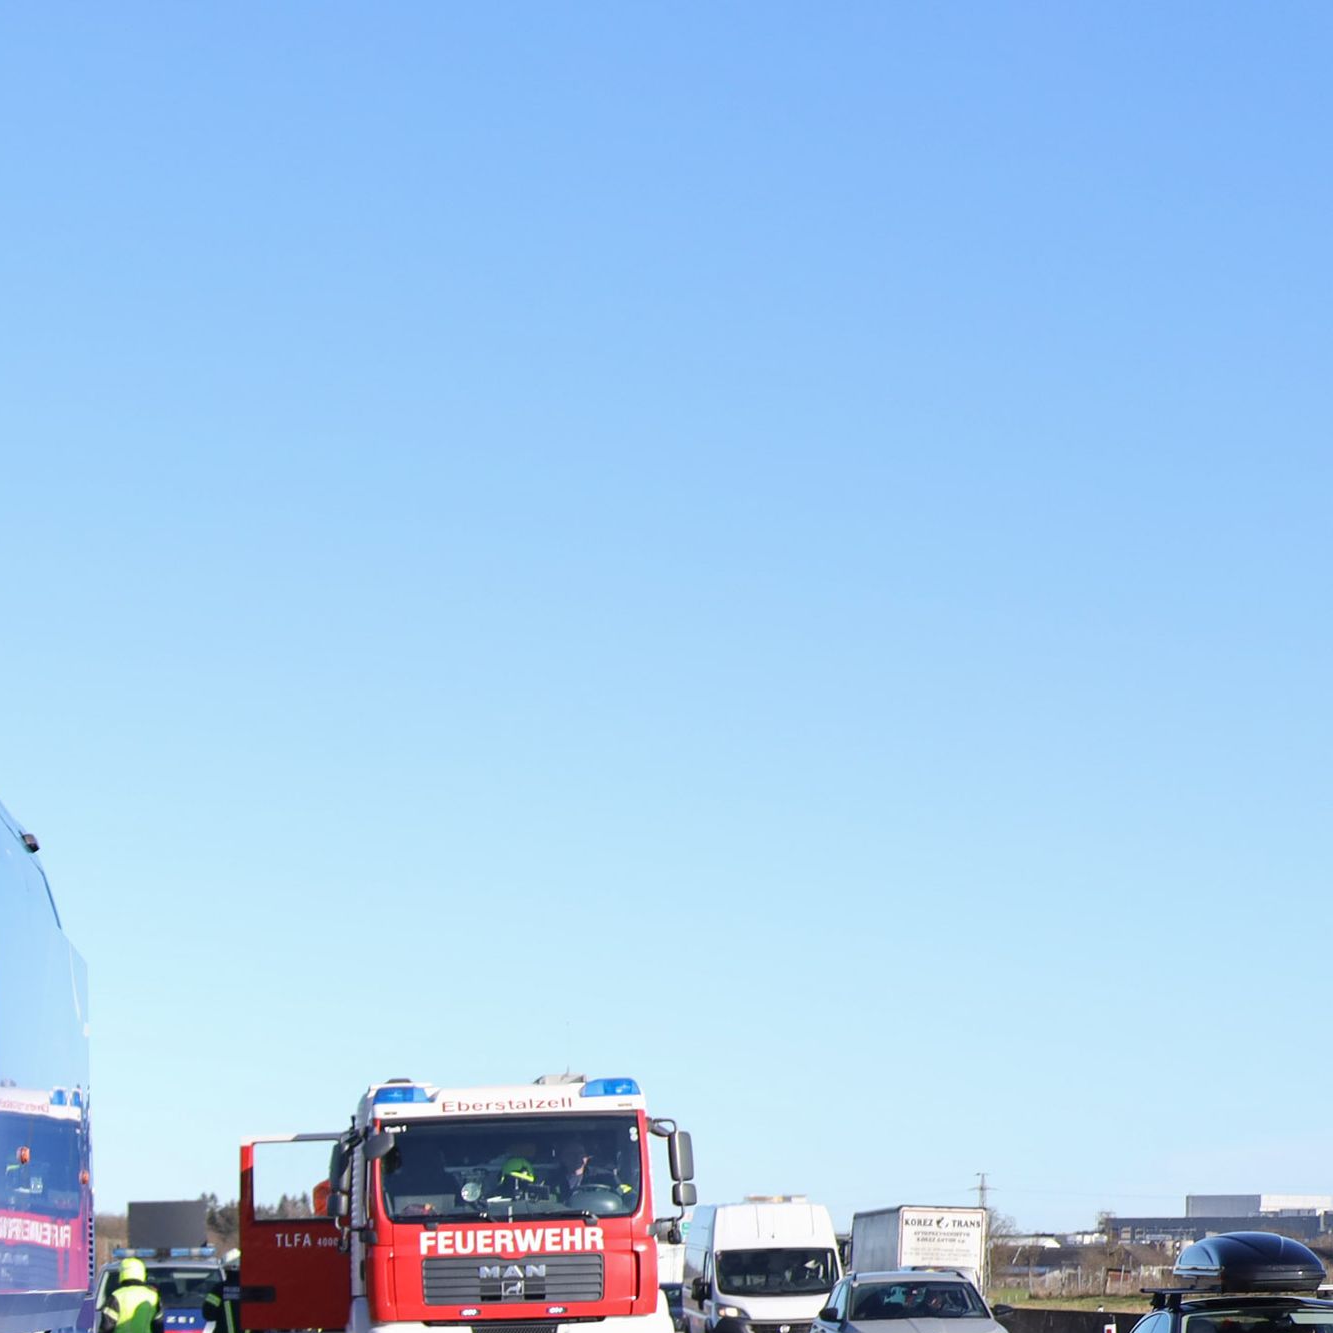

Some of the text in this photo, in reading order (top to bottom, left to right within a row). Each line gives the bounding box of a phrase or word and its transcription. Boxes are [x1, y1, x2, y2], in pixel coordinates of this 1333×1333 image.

[441, 1097, 573, 1114] Eberstalzell
[904, 1218, 981, 1229] KOREZ TRANS
[275, 1232, 311, 1248] TLFA
[419, 1226, 605, 1255] FEUERWEHR
[478, 1264, 547, 1279] MAN
